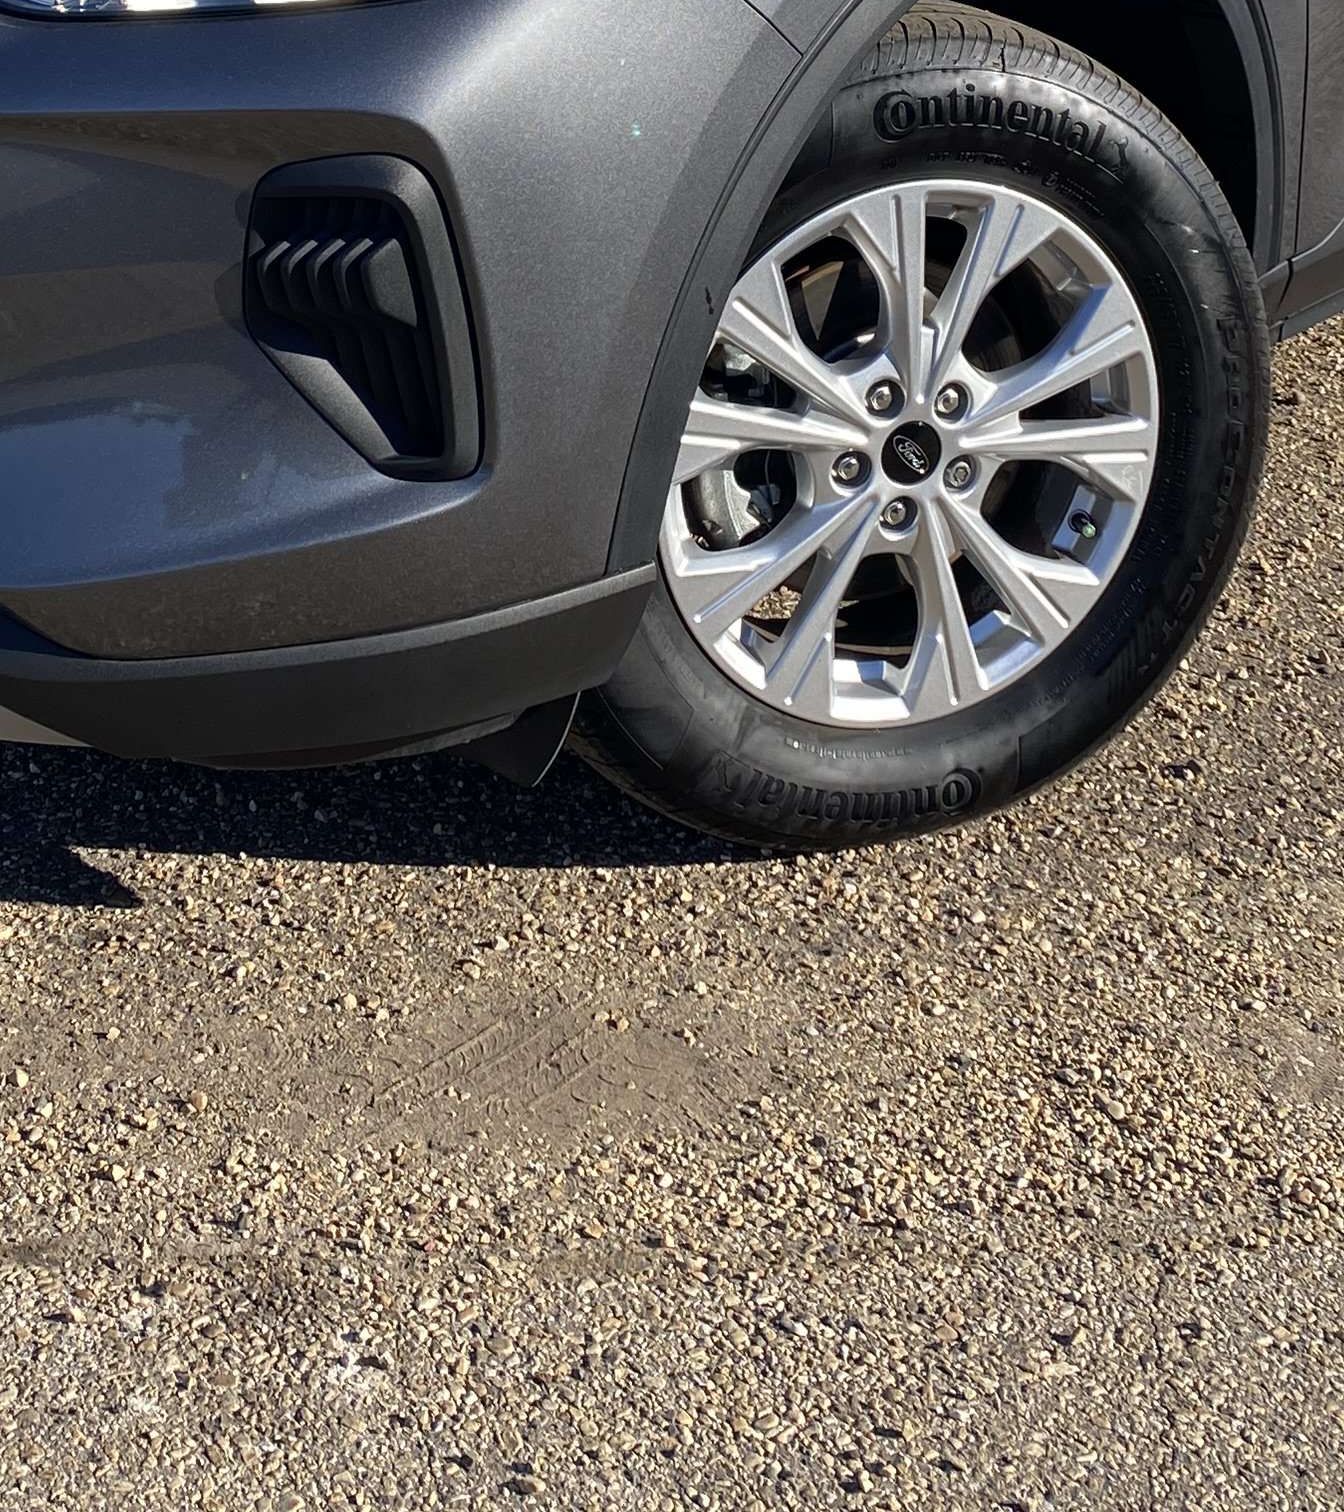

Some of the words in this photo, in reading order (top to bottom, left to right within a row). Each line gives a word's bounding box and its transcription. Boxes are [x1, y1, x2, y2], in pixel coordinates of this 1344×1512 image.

[872, 82, 1107, 163] Continental
[897, 441, 925, 468] Ford
[730, 765, 983, 826] Continental
